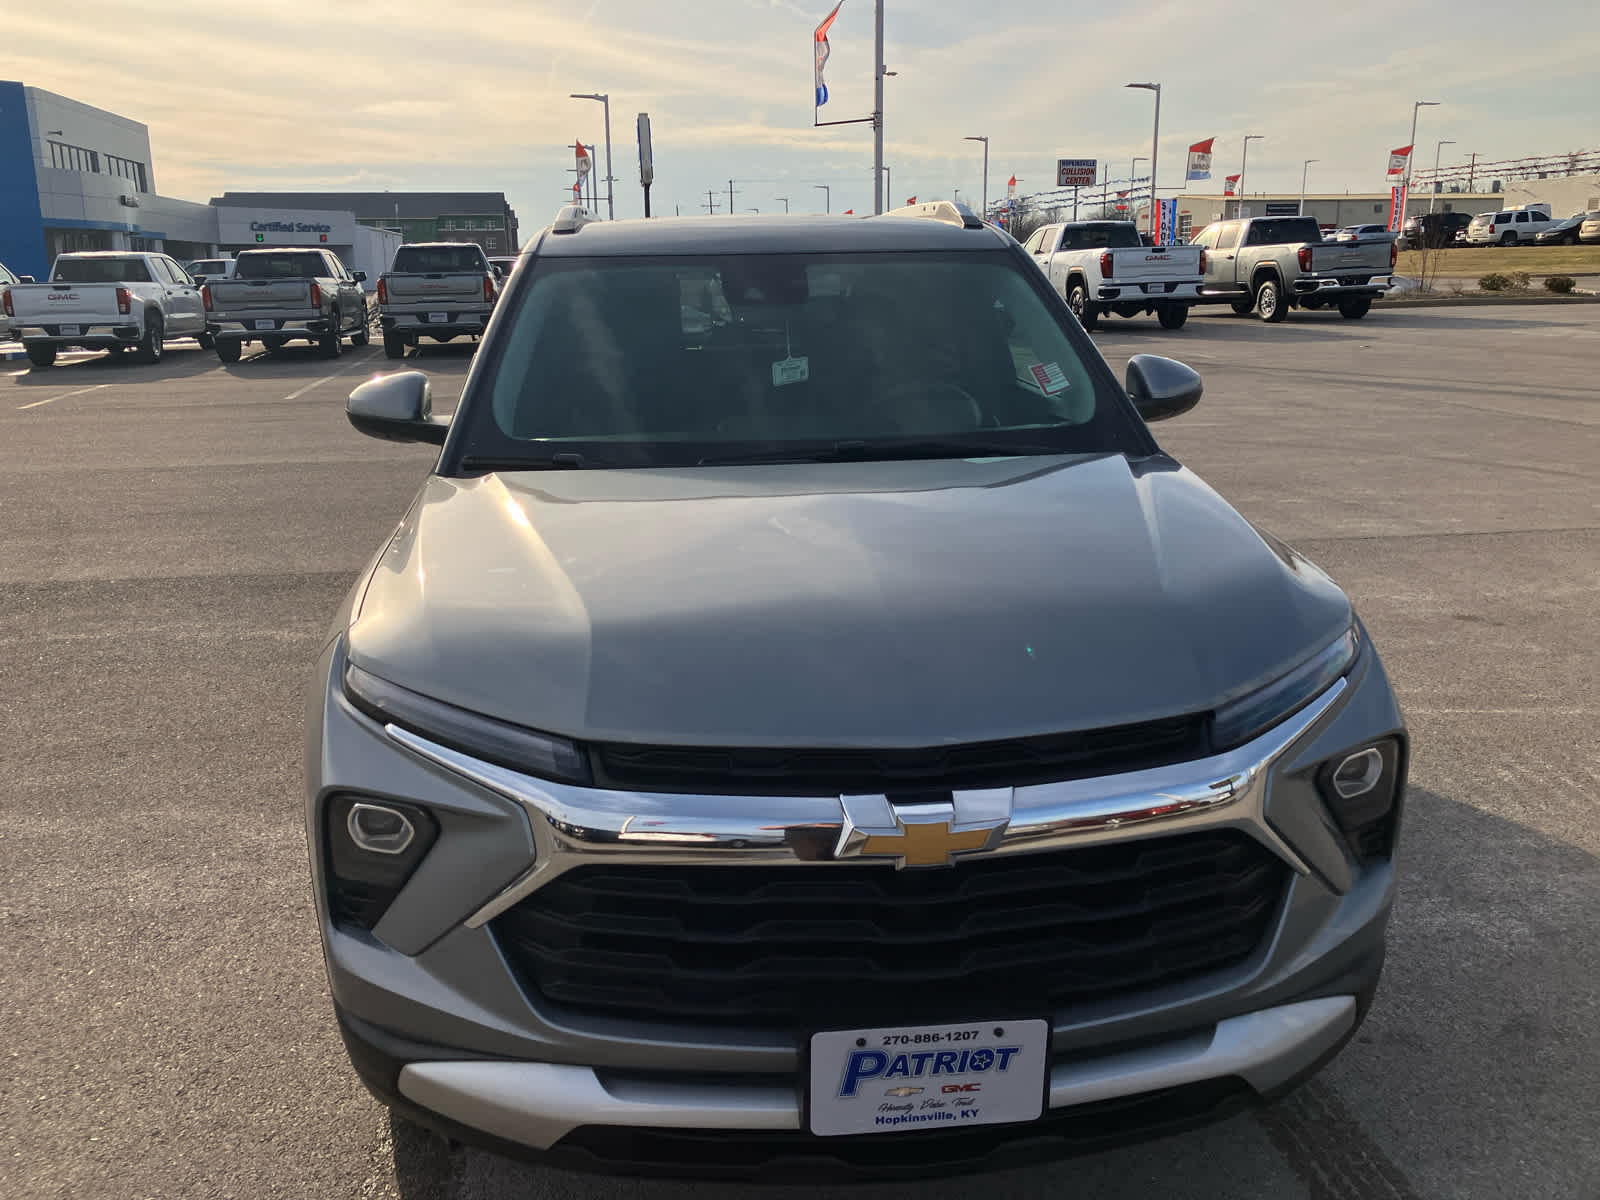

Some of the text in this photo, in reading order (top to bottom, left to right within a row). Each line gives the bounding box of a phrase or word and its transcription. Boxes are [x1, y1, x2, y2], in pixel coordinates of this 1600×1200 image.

[1062, 168, 1096, 176] COLLISION
[1065, 176, 1091, 185] CENTER
[250, 222, 331, 232] Certified Service
[883, 1031, 979, 1045] 270-886-1207
[838, 1047, 1021, 1098] PATRIOT
[941, 1083, 982, 1094] GMC
[875, 1109, 980, 1125] Hopkinsville, KY
